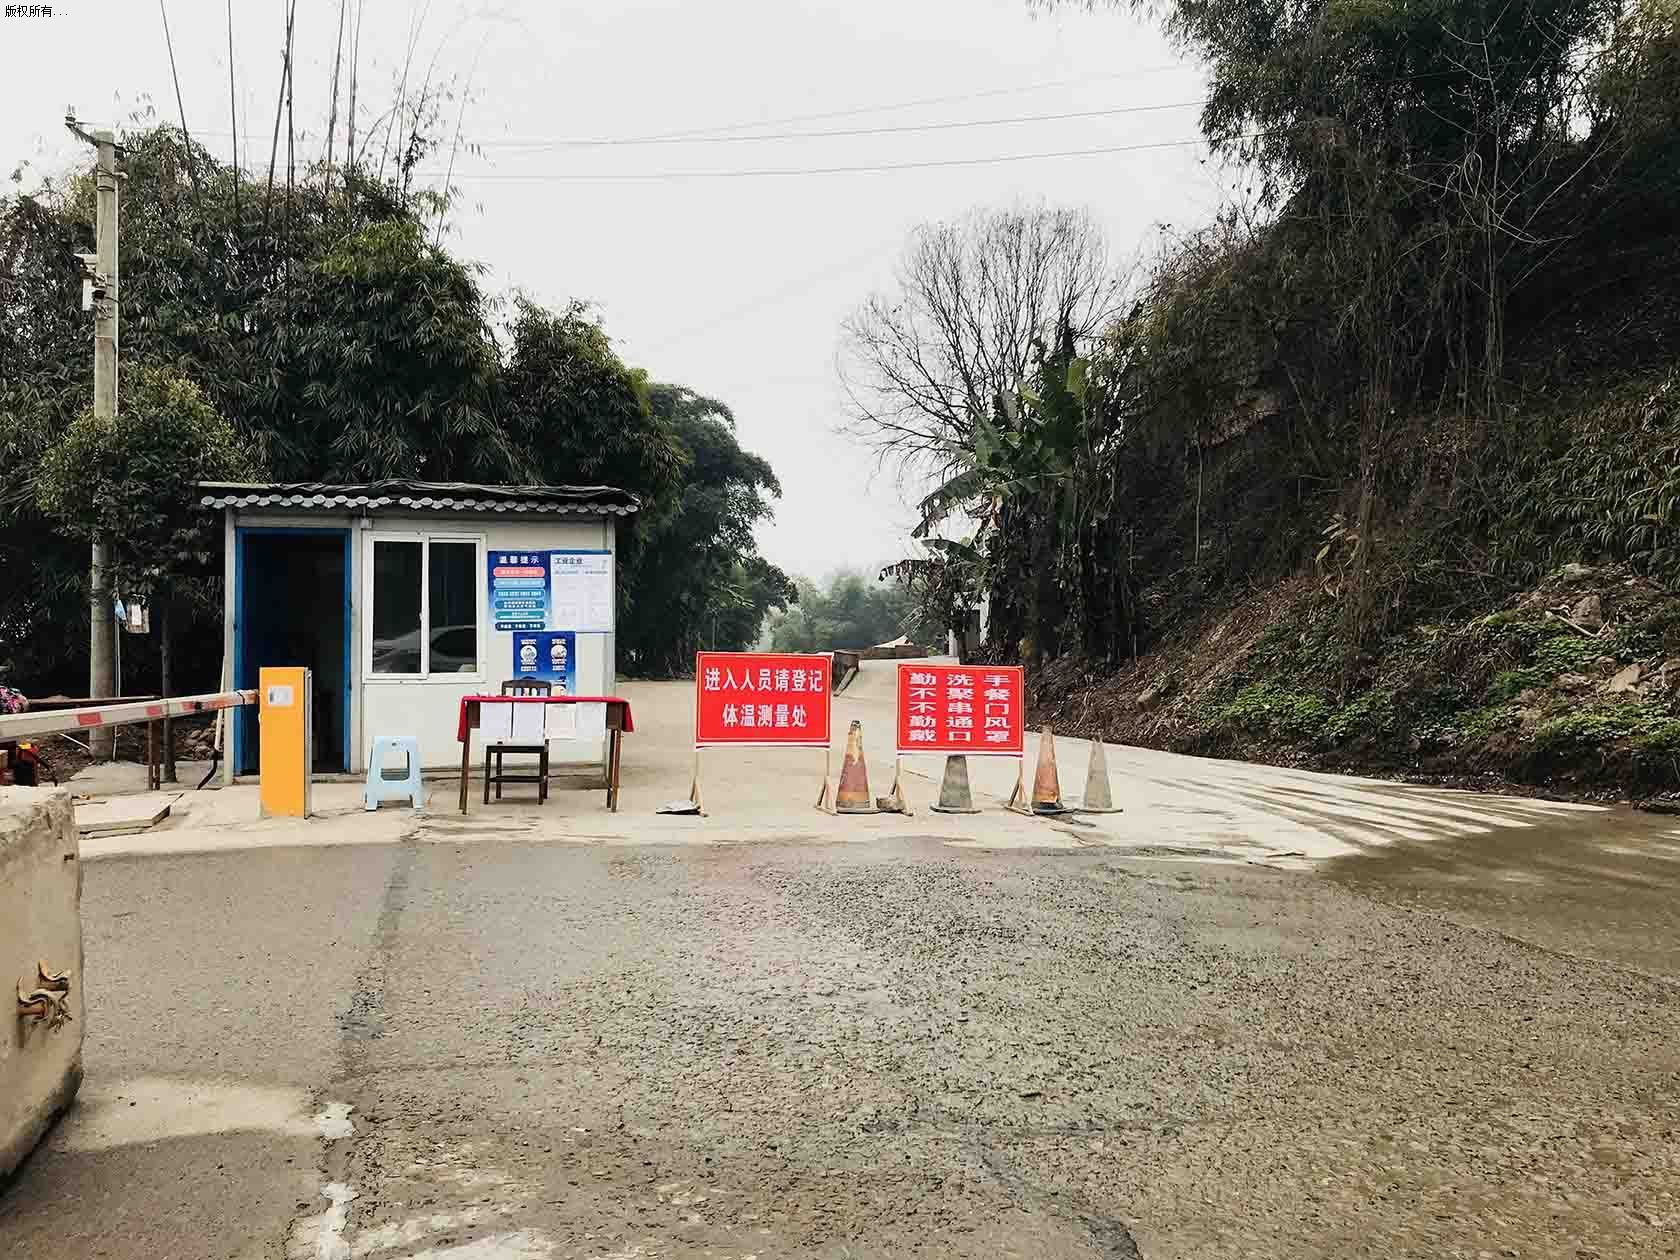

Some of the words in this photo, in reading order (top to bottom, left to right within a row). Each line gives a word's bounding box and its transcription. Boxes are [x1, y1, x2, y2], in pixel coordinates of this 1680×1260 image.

[704, 667, 824, 692] 进入人员请登记
[908, 672, 1013, 687] 勤洗手
[908, 687, 1011, 701] 不聚餐
[908, 701, 1010, 715] 不串门
[721, 703, 808, 728] 体温测量处
[908, 715, 1012, 729] 勤通风
[908, 729, 1011, 743] 戴口罩
